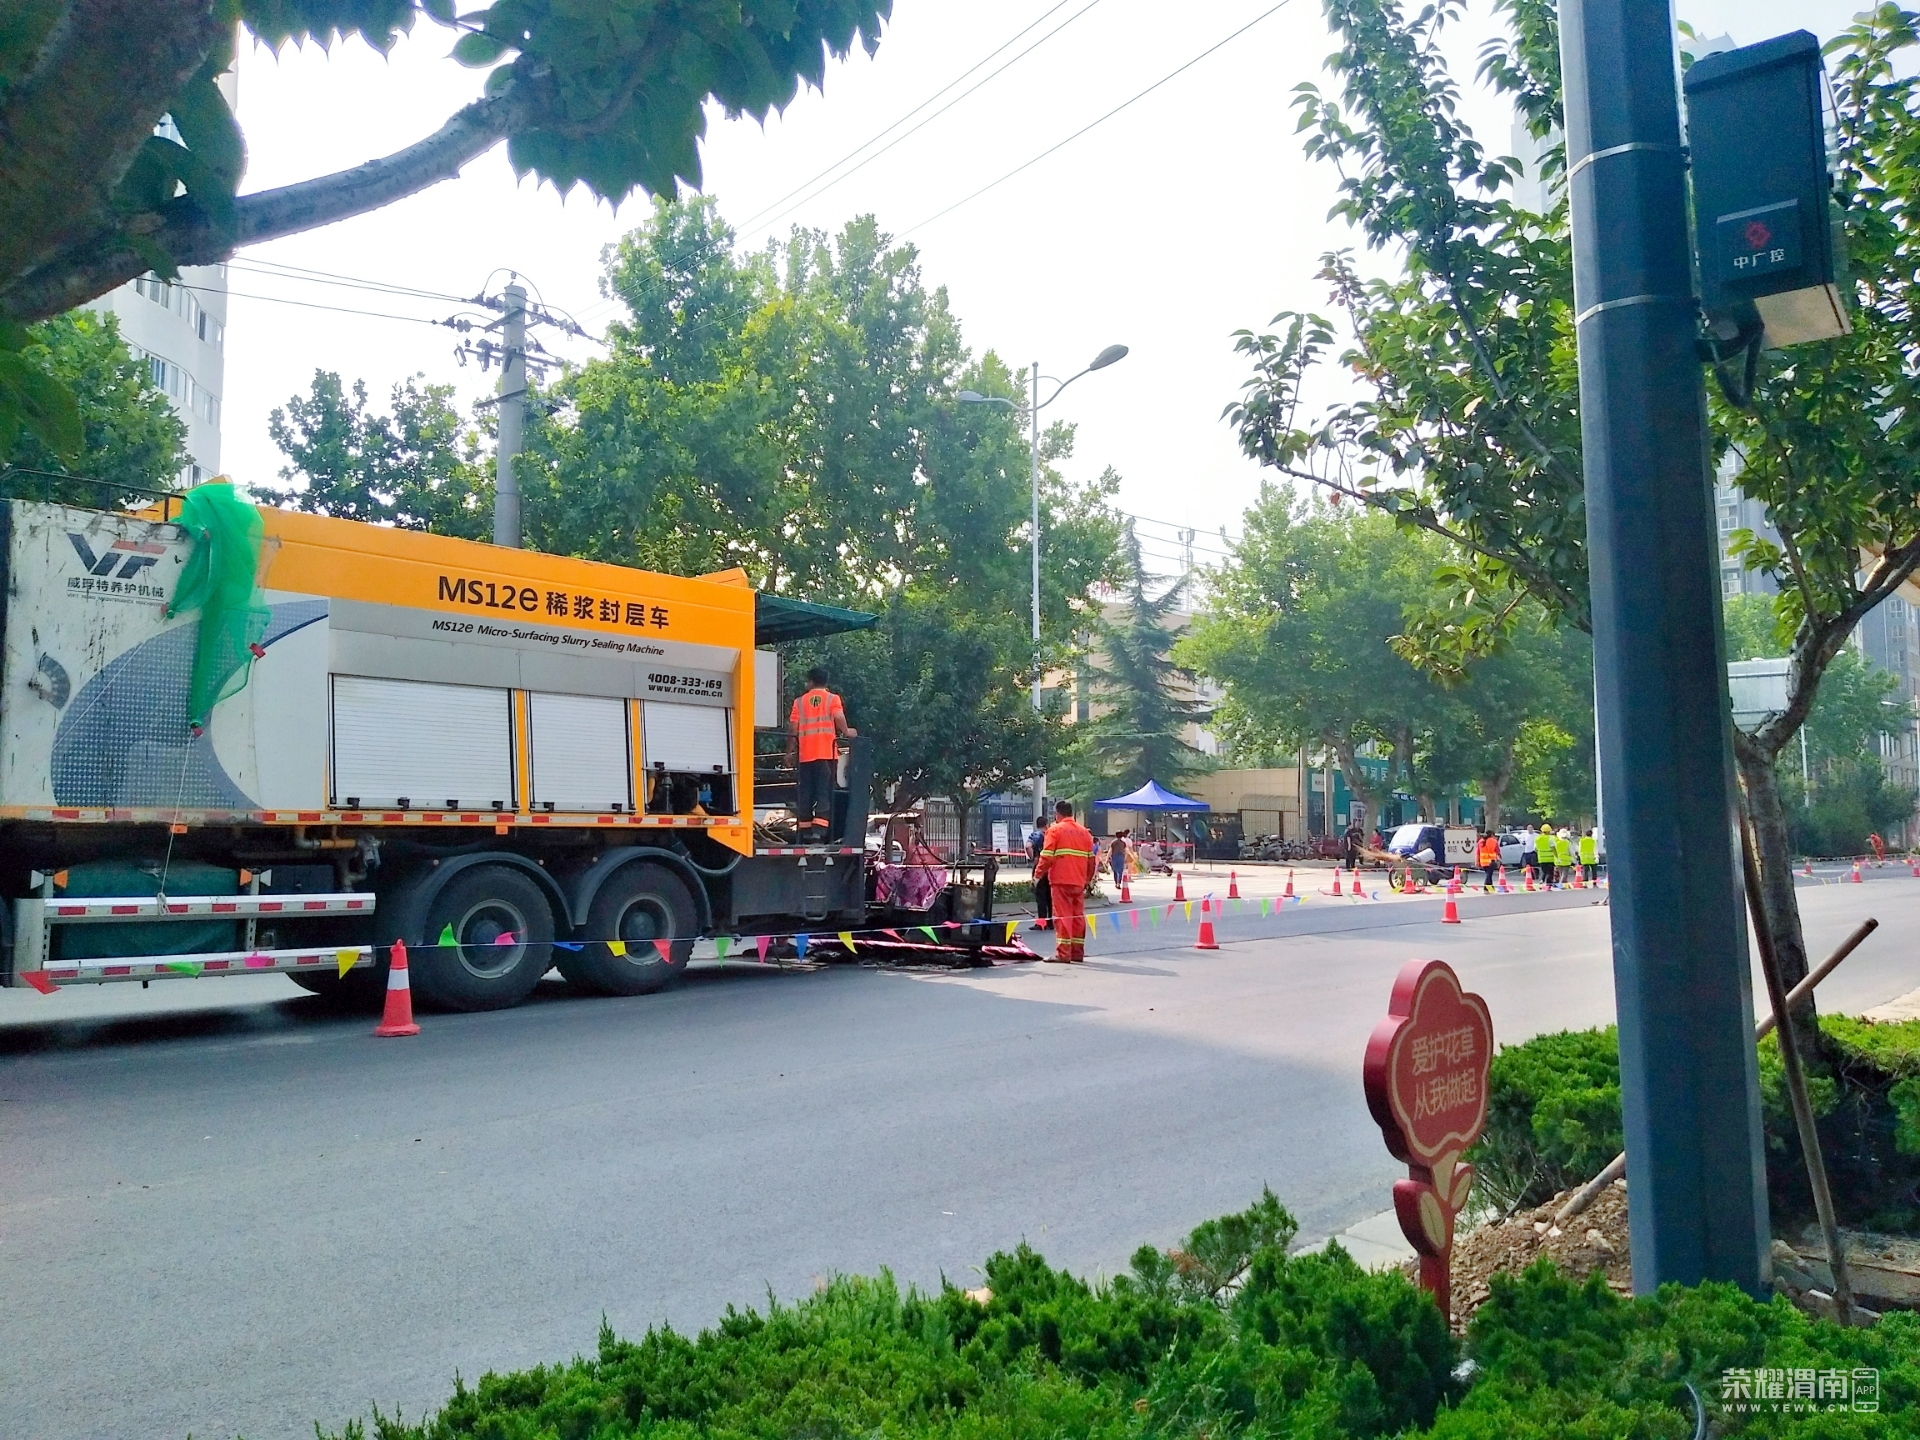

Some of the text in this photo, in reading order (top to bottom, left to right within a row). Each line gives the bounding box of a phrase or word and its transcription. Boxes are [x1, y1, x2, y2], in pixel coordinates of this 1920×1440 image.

[1733, 248, 1785, 270] 中广控
[438, 575, 670, 630] MS12e 稀浆封层车
[432, 620, 665, 656] MS12e Micro-Surfacing Slurry Sealing Machine
[648, 673, 722, 690] 4008-333-169
[648, 683, 723, 698] www.rm.com.cn
[1412, 1025, 1475, 1076] 爱护花草
[1414, 1068, 1477, 1121] 从我做起
